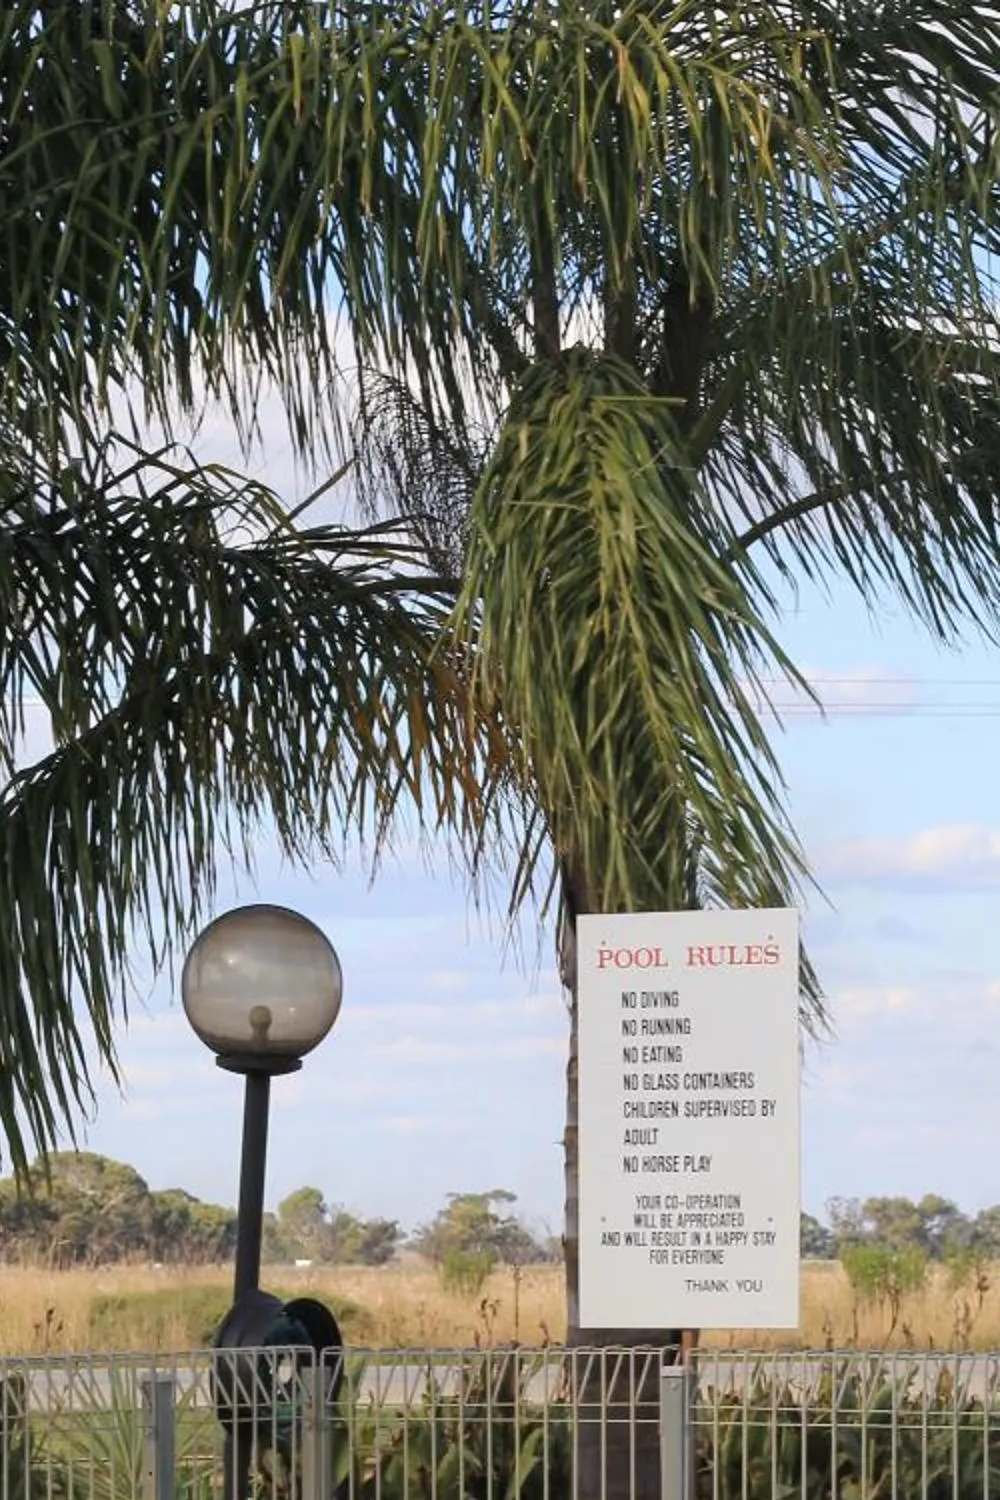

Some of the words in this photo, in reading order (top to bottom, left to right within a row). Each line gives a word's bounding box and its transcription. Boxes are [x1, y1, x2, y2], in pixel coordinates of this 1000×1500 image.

[596, 948, 669, 969] POOL
[686, 944, 780, 966] RULES
[621, 992, 637, 1008] NO
[641, 991, 679, 1008] DIVING
[621, 1019, 637, 1036] NO
[641, 1018, 691, 1036] RUNNING
[623, 1047, 638, 1063] NO
[642, 1046, 683, 1063] EATING
[623, 1074, 639, 1091] NO
[643, 1073, 680, 1091] GLASS
[683, 1072, 755, 1090] CONTAINERS
[623, 1101, 679, 1119] CHILDREN
[683, 1100, 756, 1118] SUPERVISED
[761, 1099, 776, 1116] BY
[623, 1128, 659, 1145] ADULT
[623, 1156, 639, 1173] NO
[642, 1155, 680, 1172] HORSE
[683, 1155, 712, 1172] PLAY
[635, 1195, 661, 1210] YOUR
[665, 1195, 741, 1210] CO-OPERATION
[633, 1214, 656, 1228] WILL
[660, 1214, 672, 1228] BE
[677, 1213, 745, 1228] APPRECIATED
[601, 1231, 621, 1247] AND
[624, 1231, 648, 1247] WILL
[651, 1231, 687, 1246] RESULT
[690, 1231, 701, 1246] IN
[705, 1231, 712, 1246] A
[715, 1231, 748, 1246] HAPPY
[752, 1231, 776, 1246] STAY
[649, 1249, 669, 1264] FOR
[672, 1249, 725, 1264] EVERYONE
[684, 1279, 729, 1292] THANK
[735, 1279, 763, 1292] YOU
